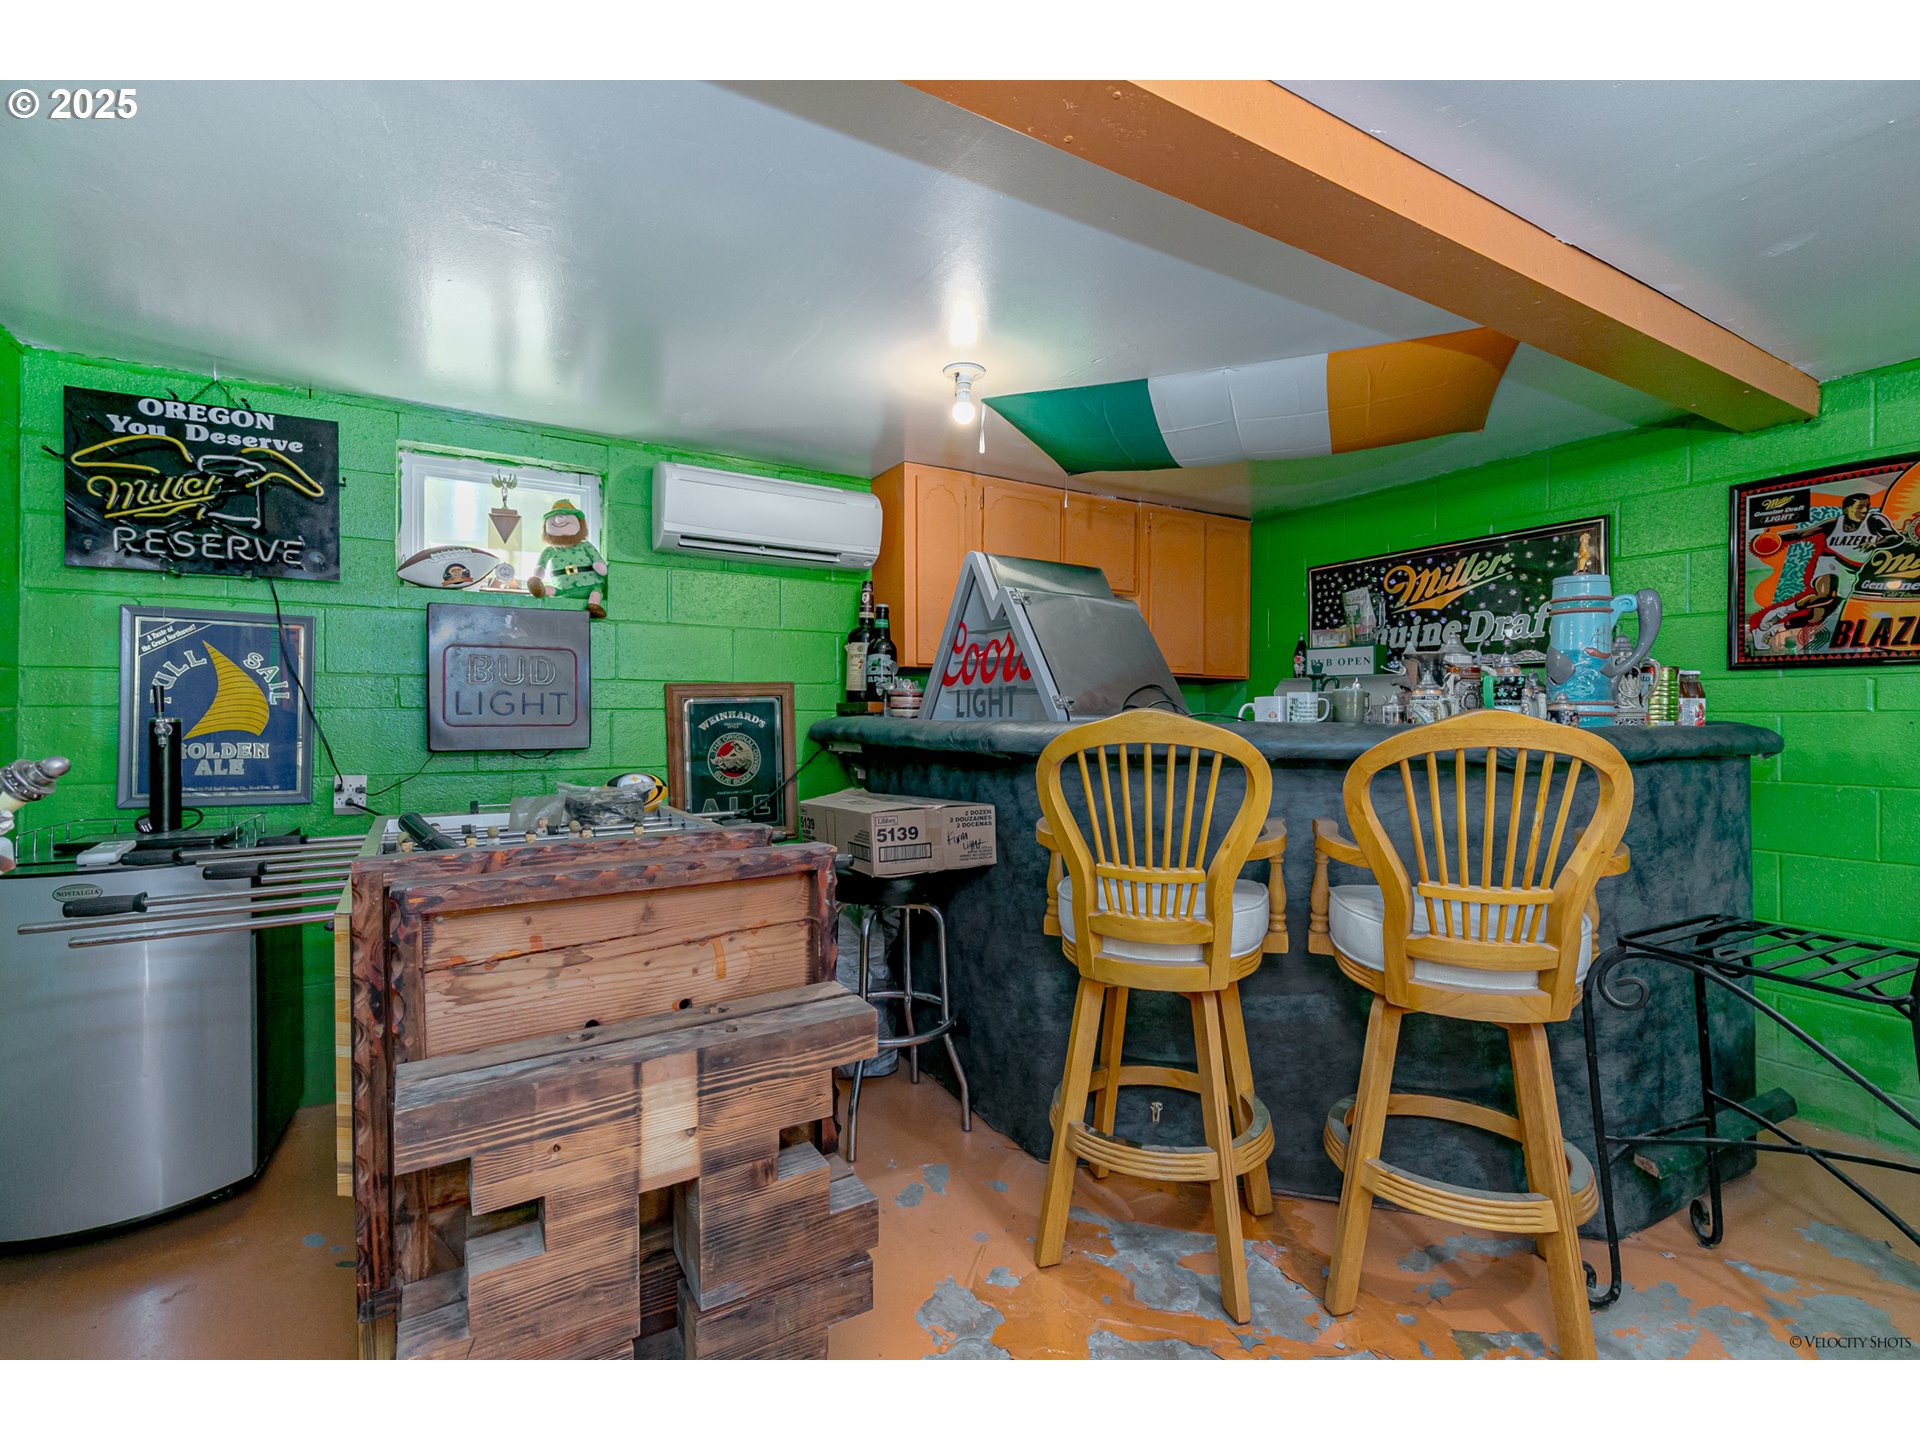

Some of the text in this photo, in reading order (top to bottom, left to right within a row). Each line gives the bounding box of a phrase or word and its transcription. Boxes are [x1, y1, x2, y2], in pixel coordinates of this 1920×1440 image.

[138, 398, 275, 431] OREGON
[106, 414, 304, 453] You Deserve
[87, 475, 222, 511] Miller
[1762, 495, 1795, 511] Miller
[1754, 505, 1805, 518] Genuine Draft
[1764, 513, 1795, 524] LIGHT
[113, 527, 305, 566] RESERVE
[1383, 552, 1513, 608] Miller
[1374, 601, 1553, 649] nuine Draf
[151, 637, 167, 648] Great
[466, 653, 557, 686] BUD
[1338, 656, 1371, 666] OPEN
[243, 652, 290, 705] SAIL
[455, 691, 568, 716] LIGHT
[956, 686, 1017, 718] LIGHT
[698, 711, 766, 730] WEINHARD'S
[194, 758, 245, 776] ALE
[955, 815, 993, 823] DOUZAINES
[877, 826, 919, 843] 5139
[56, 889, 99, 898] NOSTALGIA
